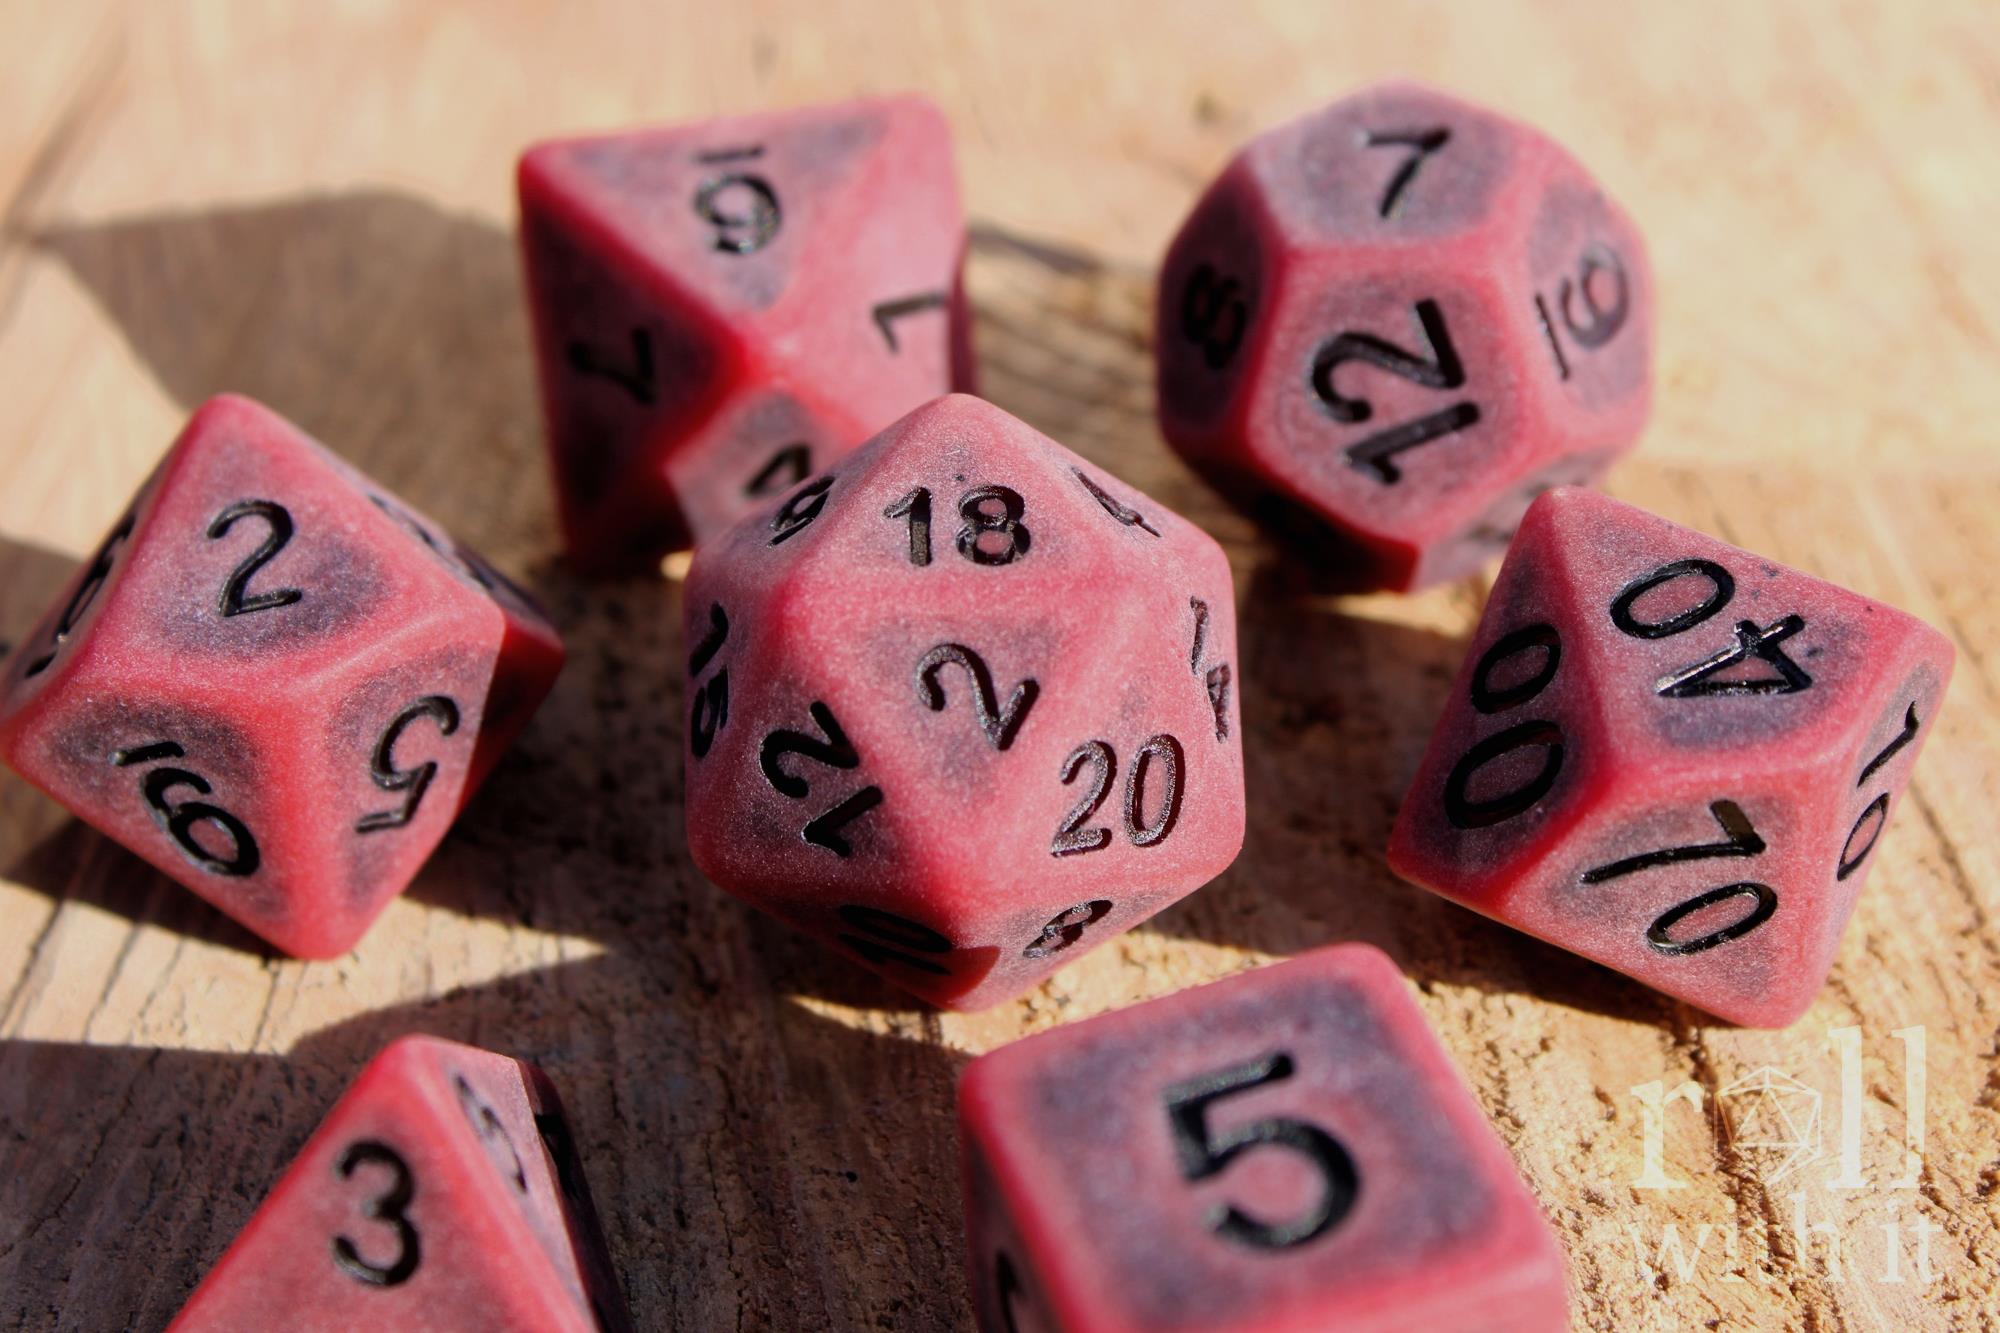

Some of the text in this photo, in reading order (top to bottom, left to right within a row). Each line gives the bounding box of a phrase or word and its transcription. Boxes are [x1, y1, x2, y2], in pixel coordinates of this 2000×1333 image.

[1355, 125, 1453, 218] 7
[1310, 298, 1481, 485] 12
[206, 498, 302, 618] 2
[884, 484, 1031, 567] 18
[1610, 558, 1813, 698] 40
[914, 642, 1040, 752] 2
[1444, 622, 1564, 831] 00
[356, 694, 460, 834] 5
[758, 700, 884, 860] 12
[1050, 734, 1186, 858] 20
[837, 904, 954, 977] 10
[1022, 898, 1113, 960] 8
[332, 1138, 422, 1288] 3
[1162, 1052, 1366, 1252] 5
